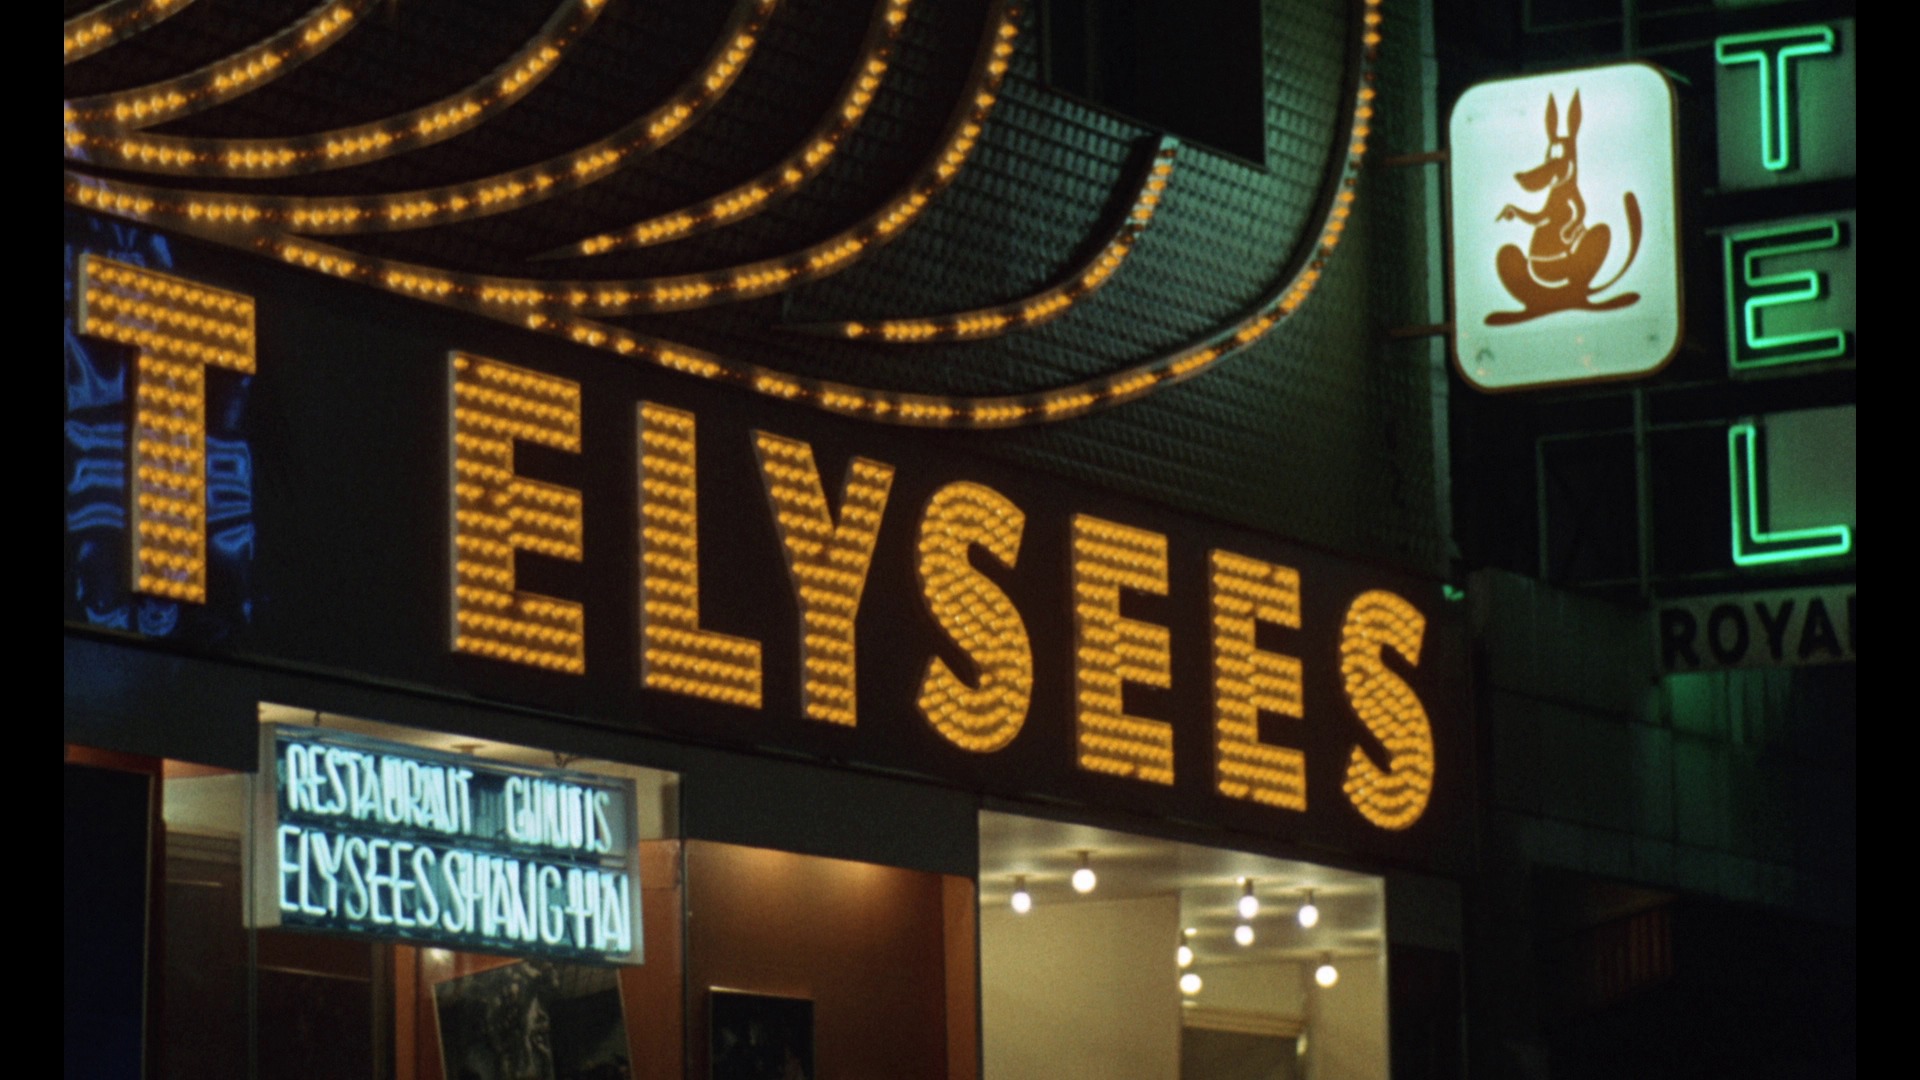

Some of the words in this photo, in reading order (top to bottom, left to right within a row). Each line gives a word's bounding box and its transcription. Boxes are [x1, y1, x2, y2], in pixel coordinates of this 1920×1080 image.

[78, 253, 256, 604] T
[449, 350, 1435, 831] ELYSEES
[1659, 595, 1857, 670] ROYA
[278, 825, 440, 928] ELYSEES
